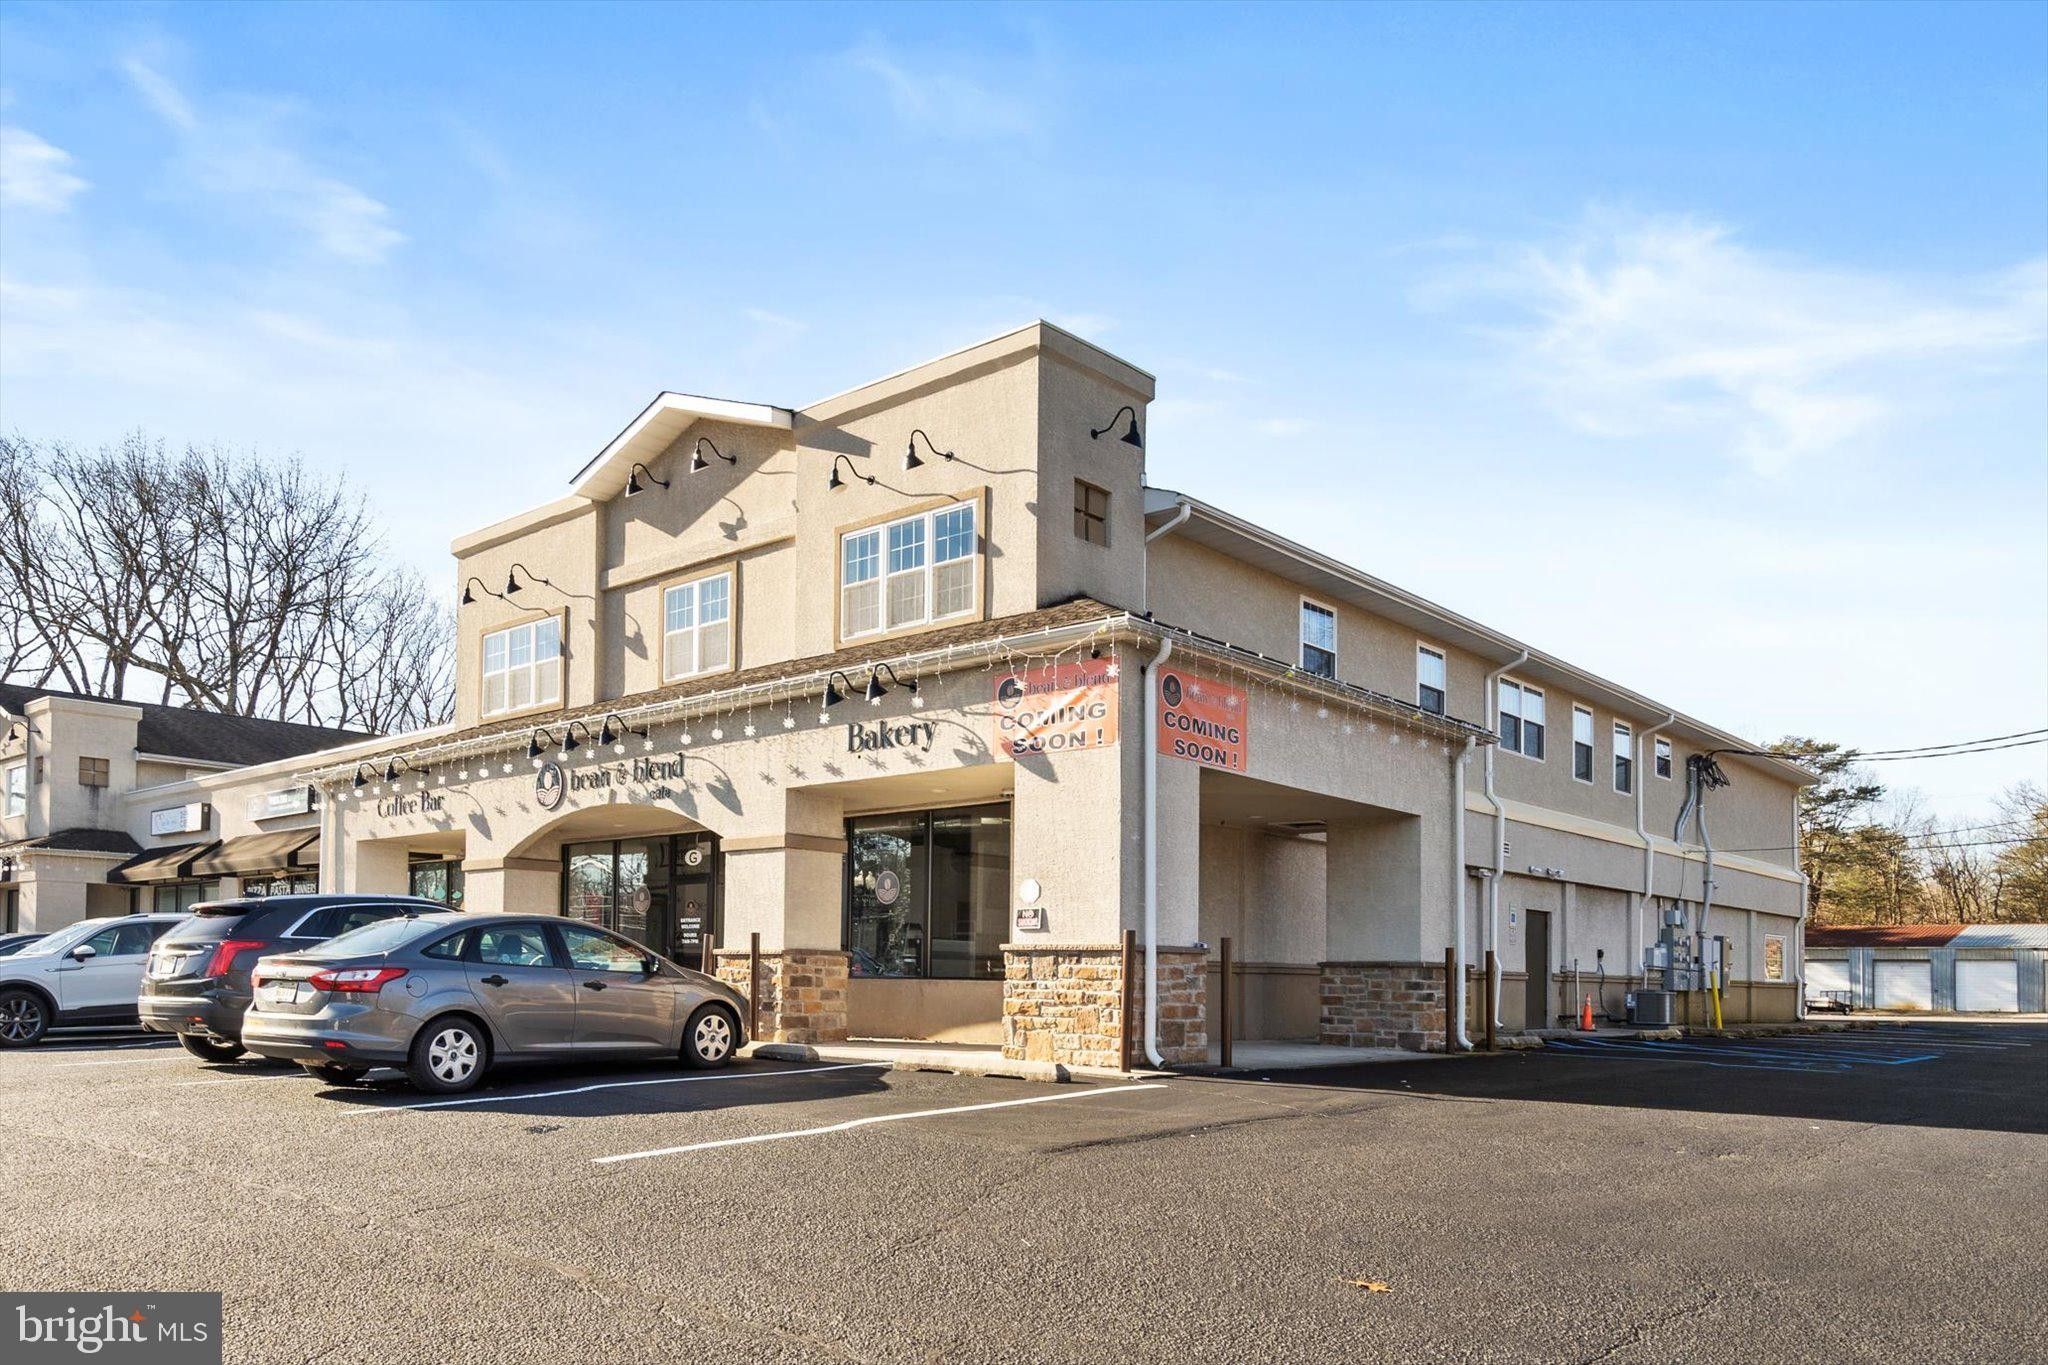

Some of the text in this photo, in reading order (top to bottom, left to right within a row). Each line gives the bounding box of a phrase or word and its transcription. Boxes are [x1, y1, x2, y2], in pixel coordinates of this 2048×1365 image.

[1000, 703, 1106, 730] COMING
[1164, 711, 1240, 744] COMING
[847, 720, 939, 753] Bakery
[1012, 731, 1086, 754] SOON
[1174, 739, 1227, 765] SOON
[570, 752, 685, 791] bean & blend
[377, 790, 445, 818] Coffee Bar
[688, 851, 698, 864] G
[270, 885, 291, 896] PASTA
